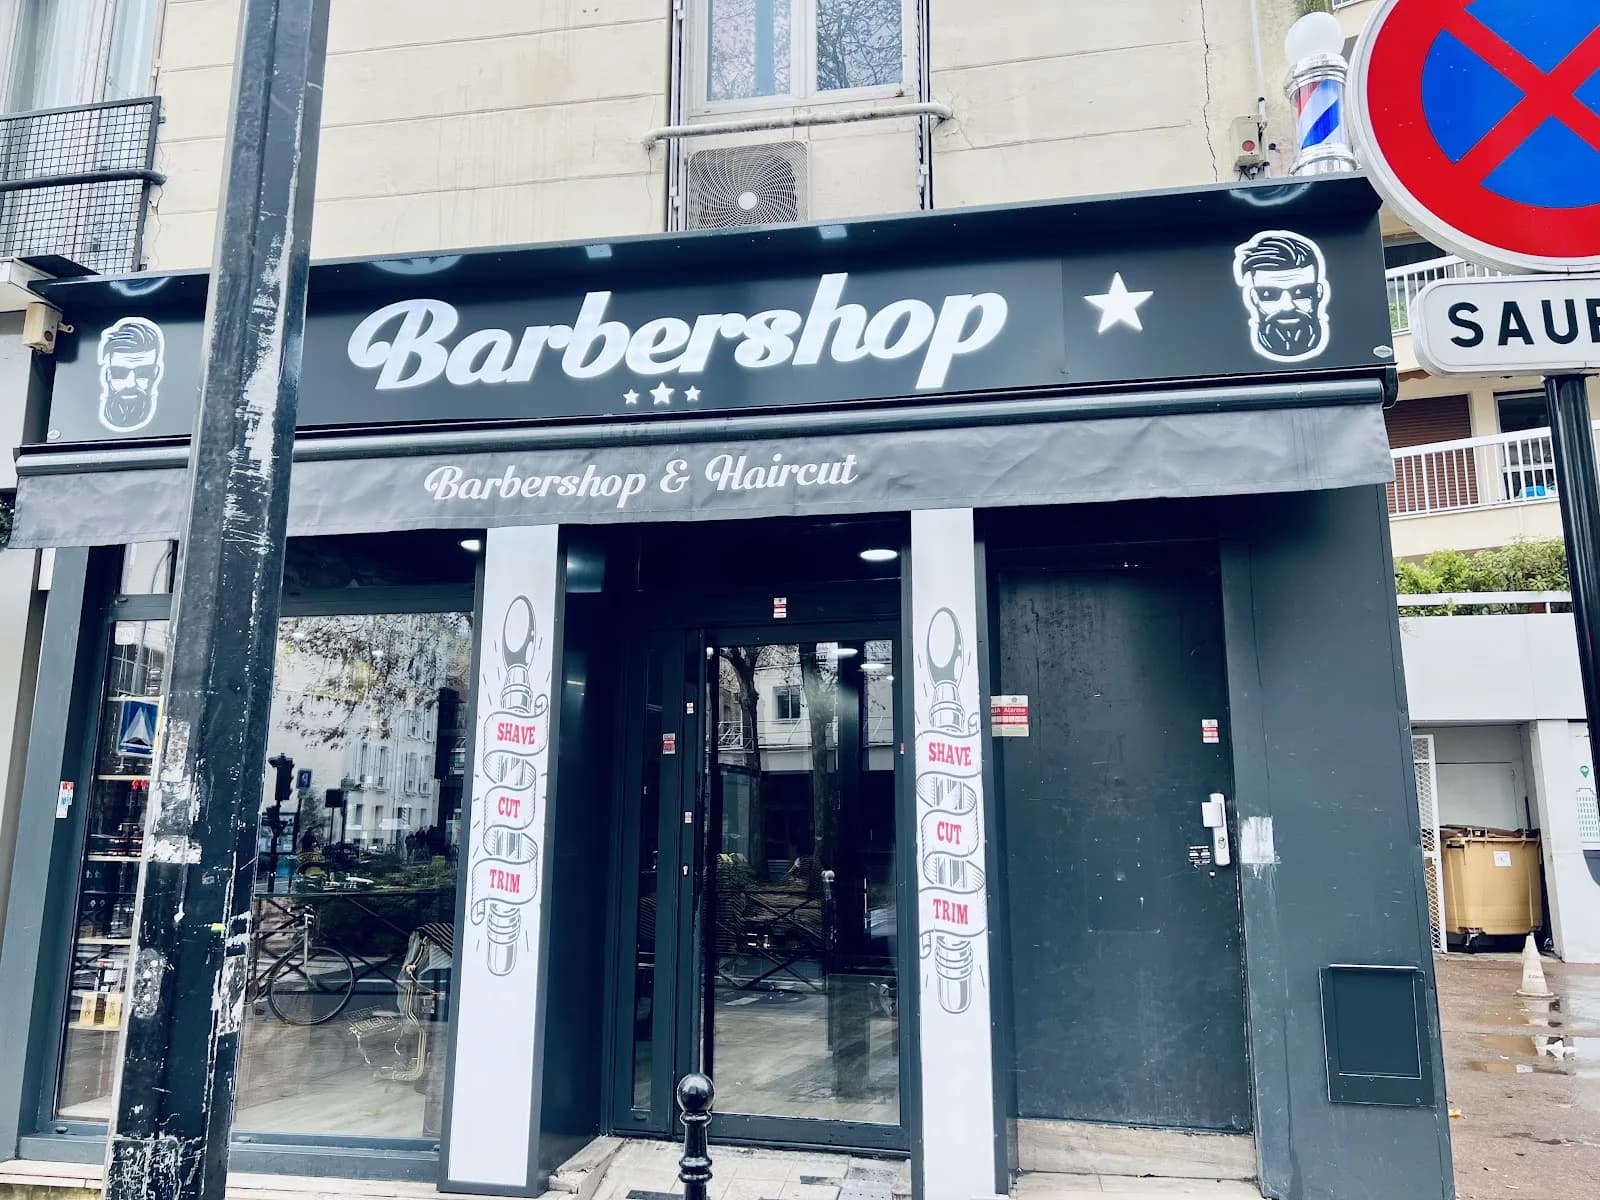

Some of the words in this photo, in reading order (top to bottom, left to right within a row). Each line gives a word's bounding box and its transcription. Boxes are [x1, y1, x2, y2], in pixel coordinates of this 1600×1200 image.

[347, 272, 1009, 390] Barbershop
[423, 464, 647, 509] Barbershop
[659, 459, 690, 493] &
[705, 453, 858, 491] Haircut
[497, 722, 536, 745] SHAVE
[928, 742, 972, 767] SHAVE
[497, 797, 521, 818] CUT
[937, 821, 962, 844] CUT
[489, 869, 521, 893] TRIM
[933, 898, 969, 924] TRIM
